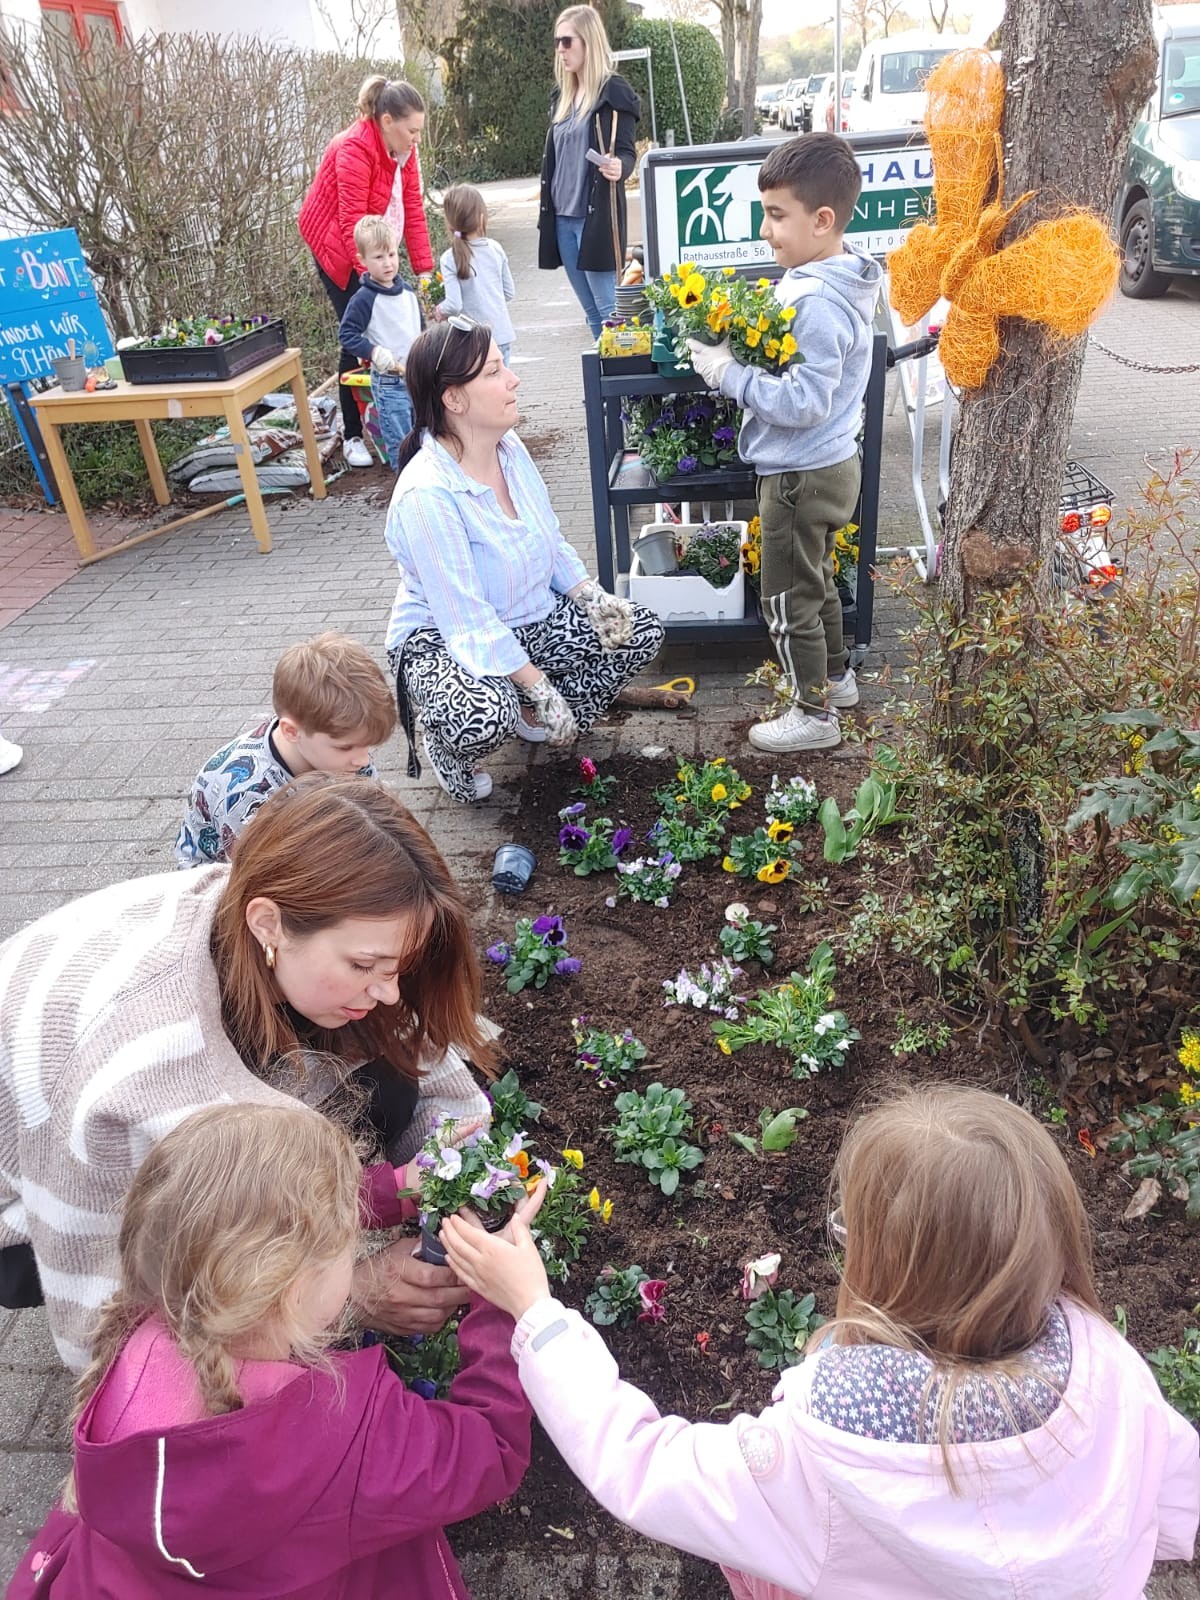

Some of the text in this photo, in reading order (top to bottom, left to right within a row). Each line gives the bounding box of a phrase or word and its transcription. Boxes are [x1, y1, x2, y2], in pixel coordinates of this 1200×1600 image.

[862, 158, 934, 184] HAU
[851, 197, 932, 221] NHEI
[683, 246, 766, 262] Rathausstraße 56
[0, 320, 45, 346] INDEN
